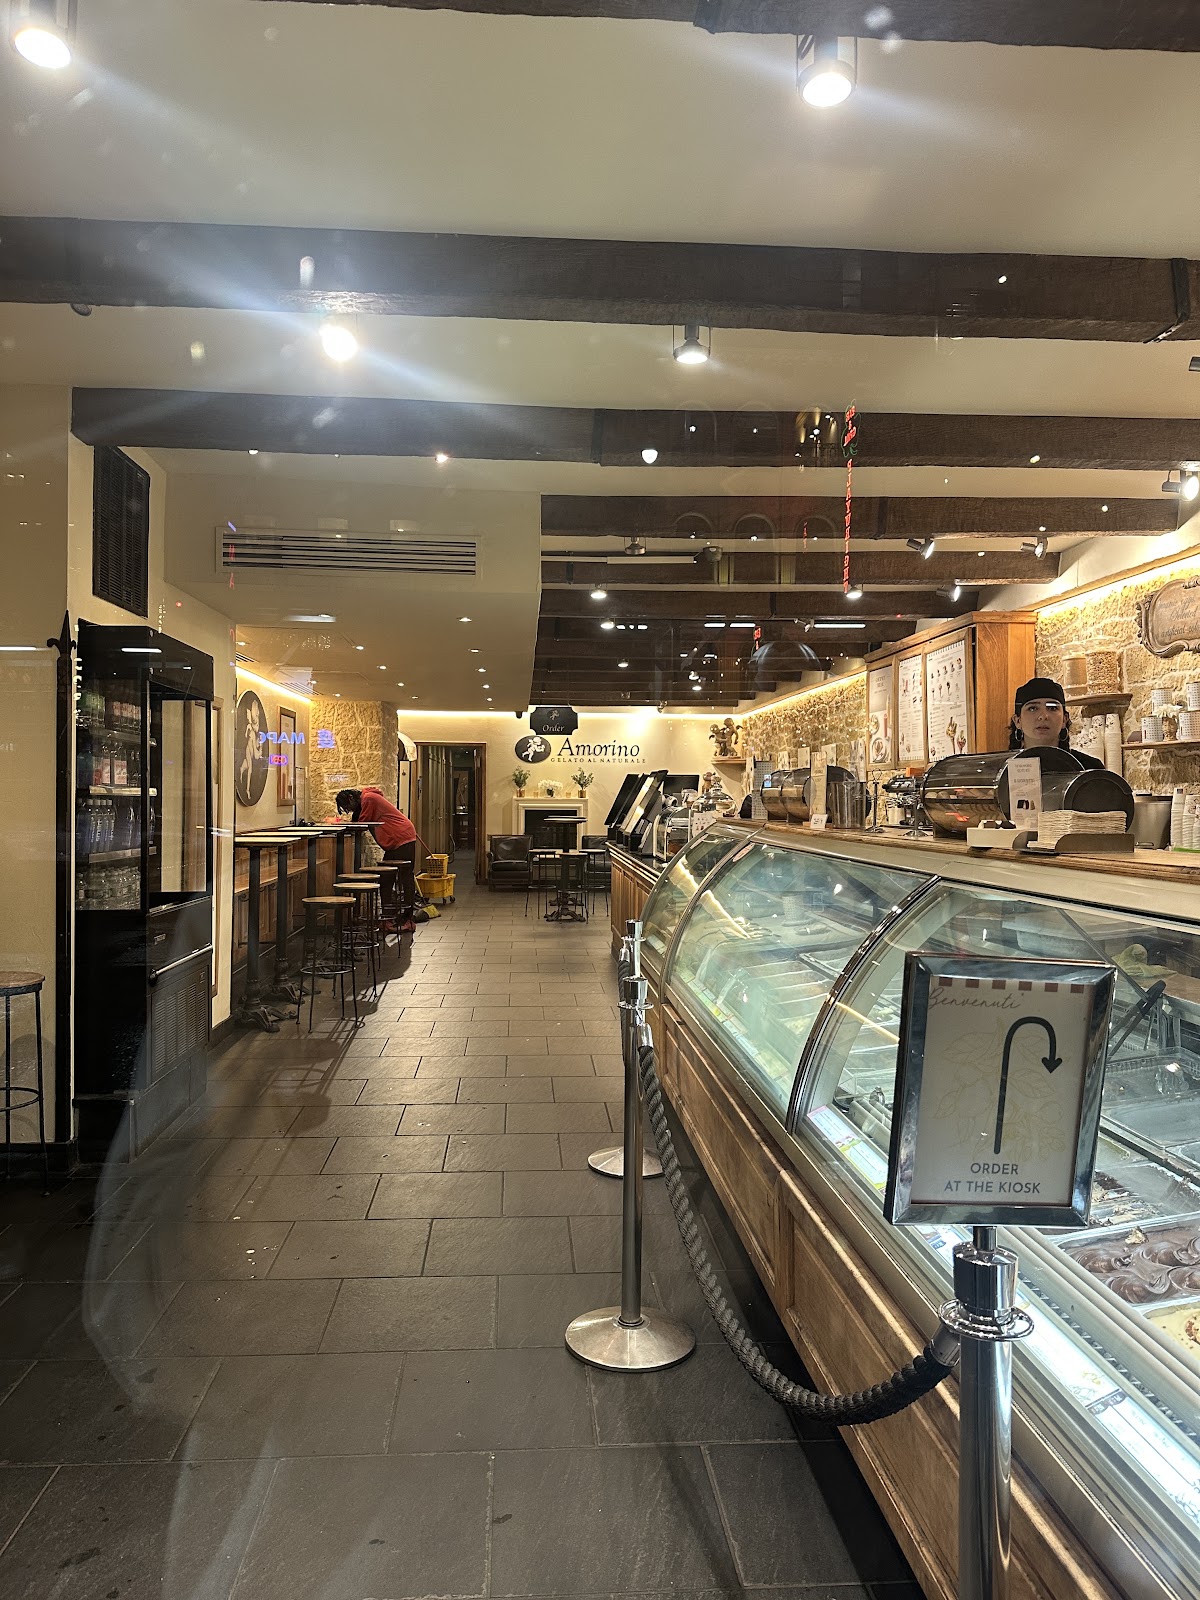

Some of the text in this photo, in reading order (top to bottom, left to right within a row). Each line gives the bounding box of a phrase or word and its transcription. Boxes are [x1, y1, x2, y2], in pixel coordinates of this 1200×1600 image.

[542, 722, 565, 732] Order
[557, 737, 640, 757] Amorino
[927, 986, 1024, 1010] Benvenuti
[970, 1162, 1019, 1175] ORDER
[943, 1180, 1041, 1194] AT THE KIOSK
